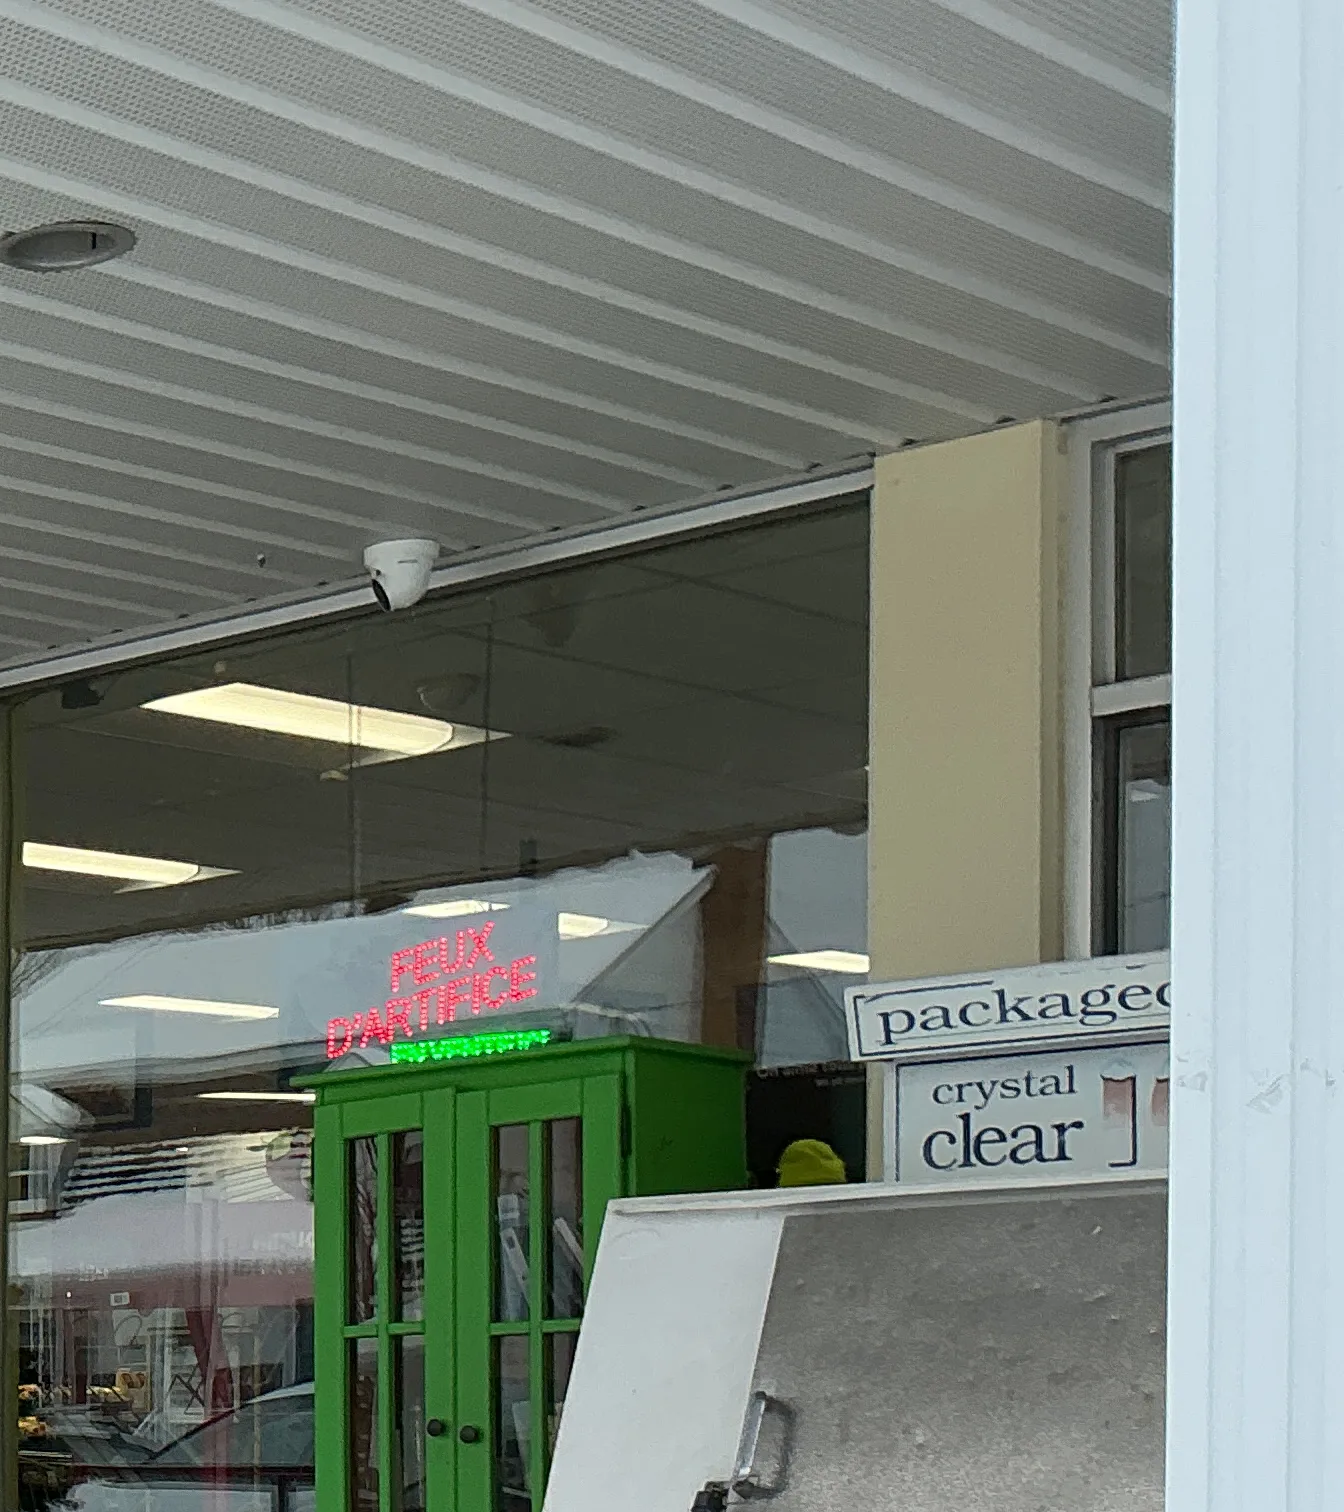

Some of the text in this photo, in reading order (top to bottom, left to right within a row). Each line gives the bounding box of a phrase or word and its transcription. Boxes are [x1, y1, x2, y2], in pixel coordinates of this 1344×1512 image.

[391, 920, 496, 993] FEUX
[326, 954, 538, 1060] D'ARTIFICE
[931, 1064, 1077, 1111] crystal
[922, 1112, 1085, 1171] clear
